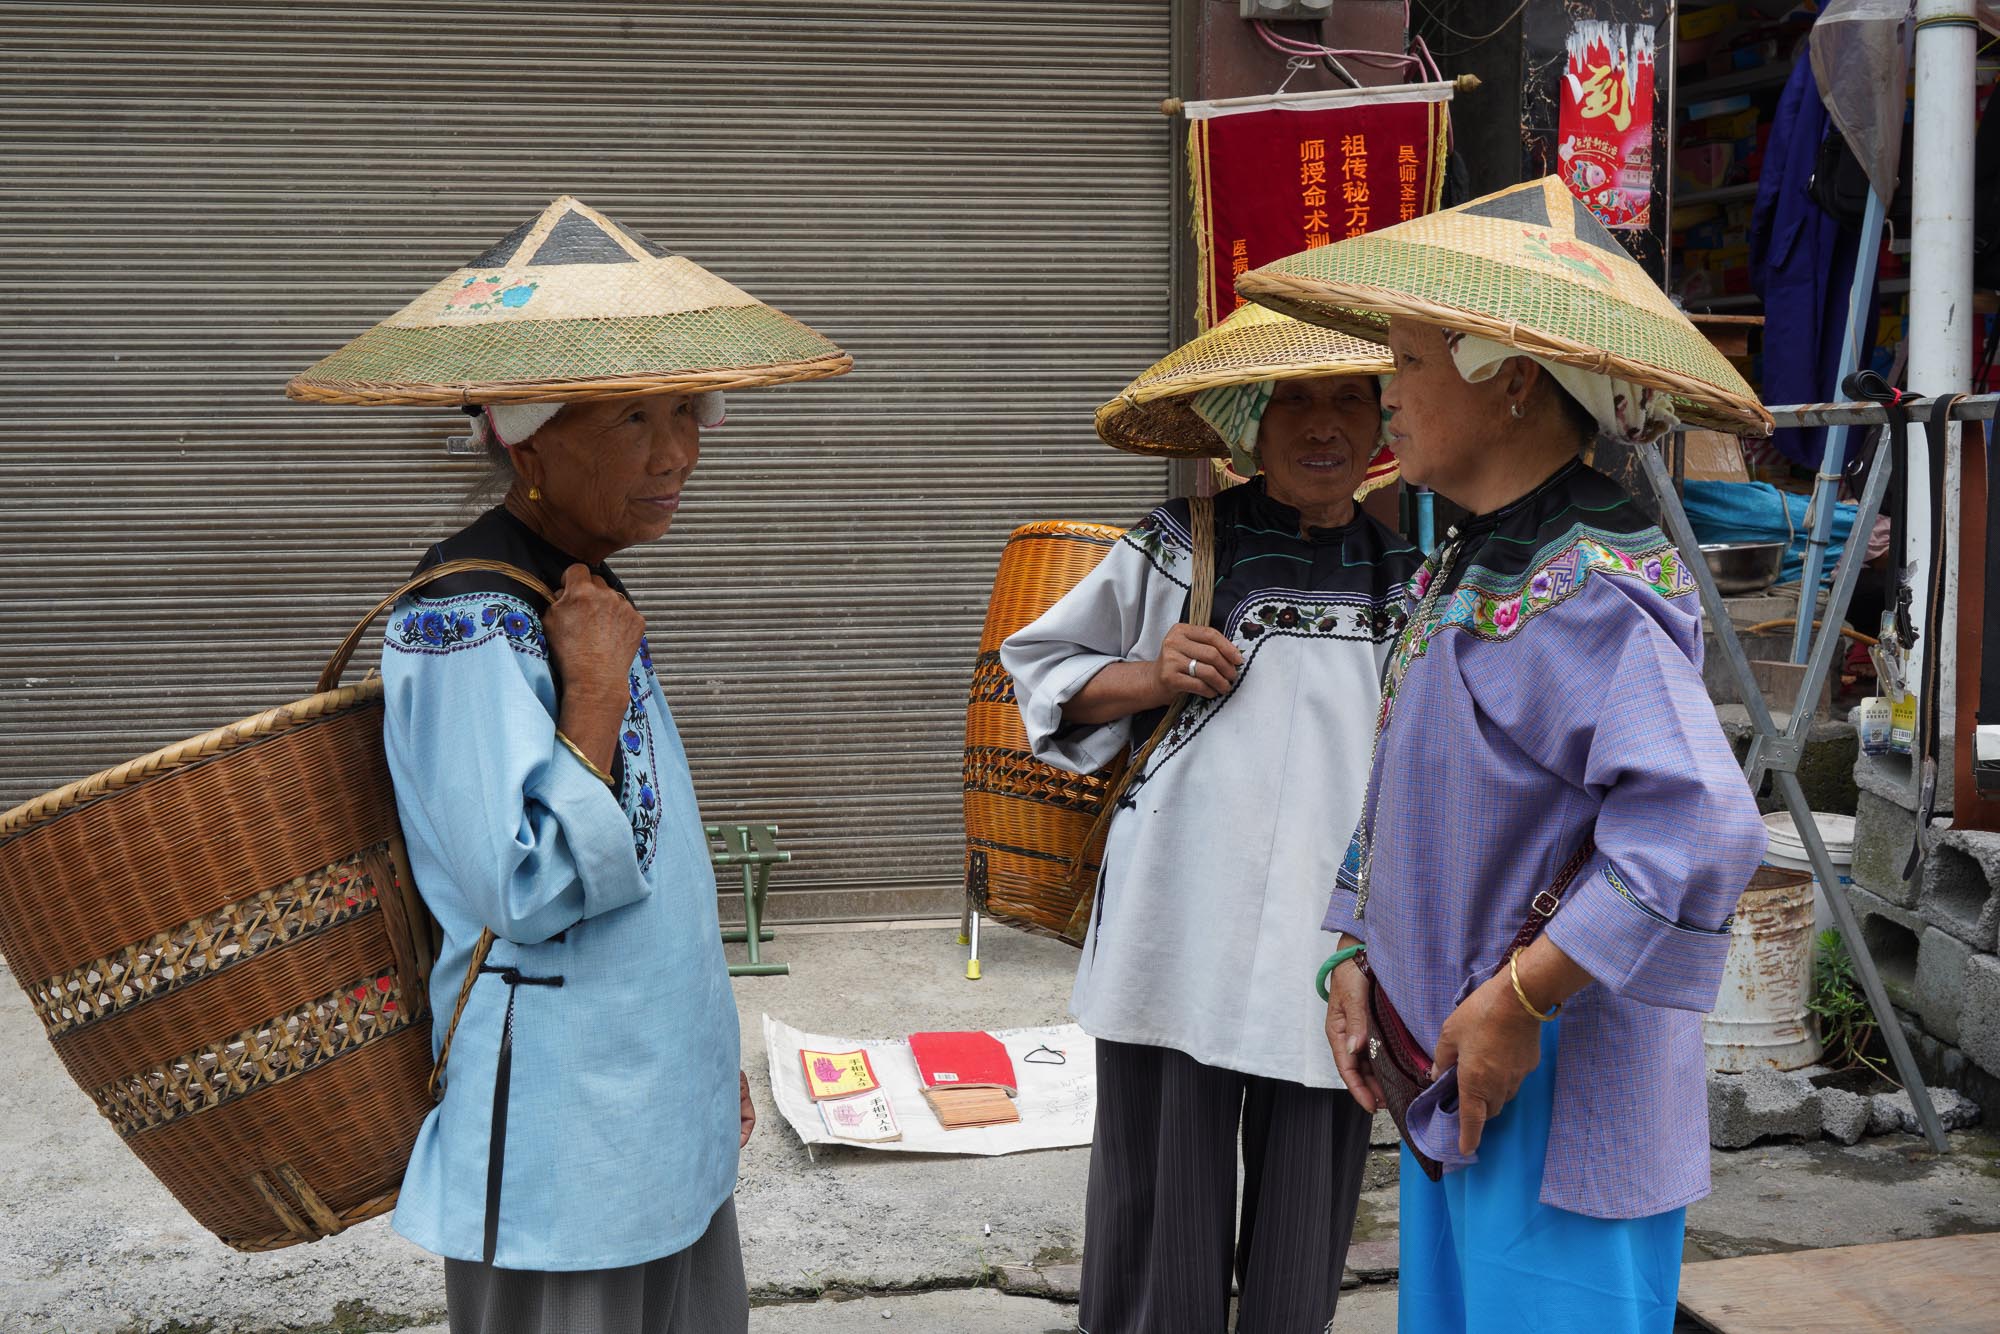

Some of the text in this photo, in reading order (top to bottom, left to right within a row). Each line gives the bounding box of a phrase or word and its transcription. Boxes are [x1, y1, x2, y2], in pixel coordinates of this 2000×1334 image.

[1580, 50, 1632, 132] 到
[1299, 139, 1330, 251] 师授命术测
[849, 1058, 869, 1087] 手相与人生
[870, 1097, 893, 1132] 手相与人生
